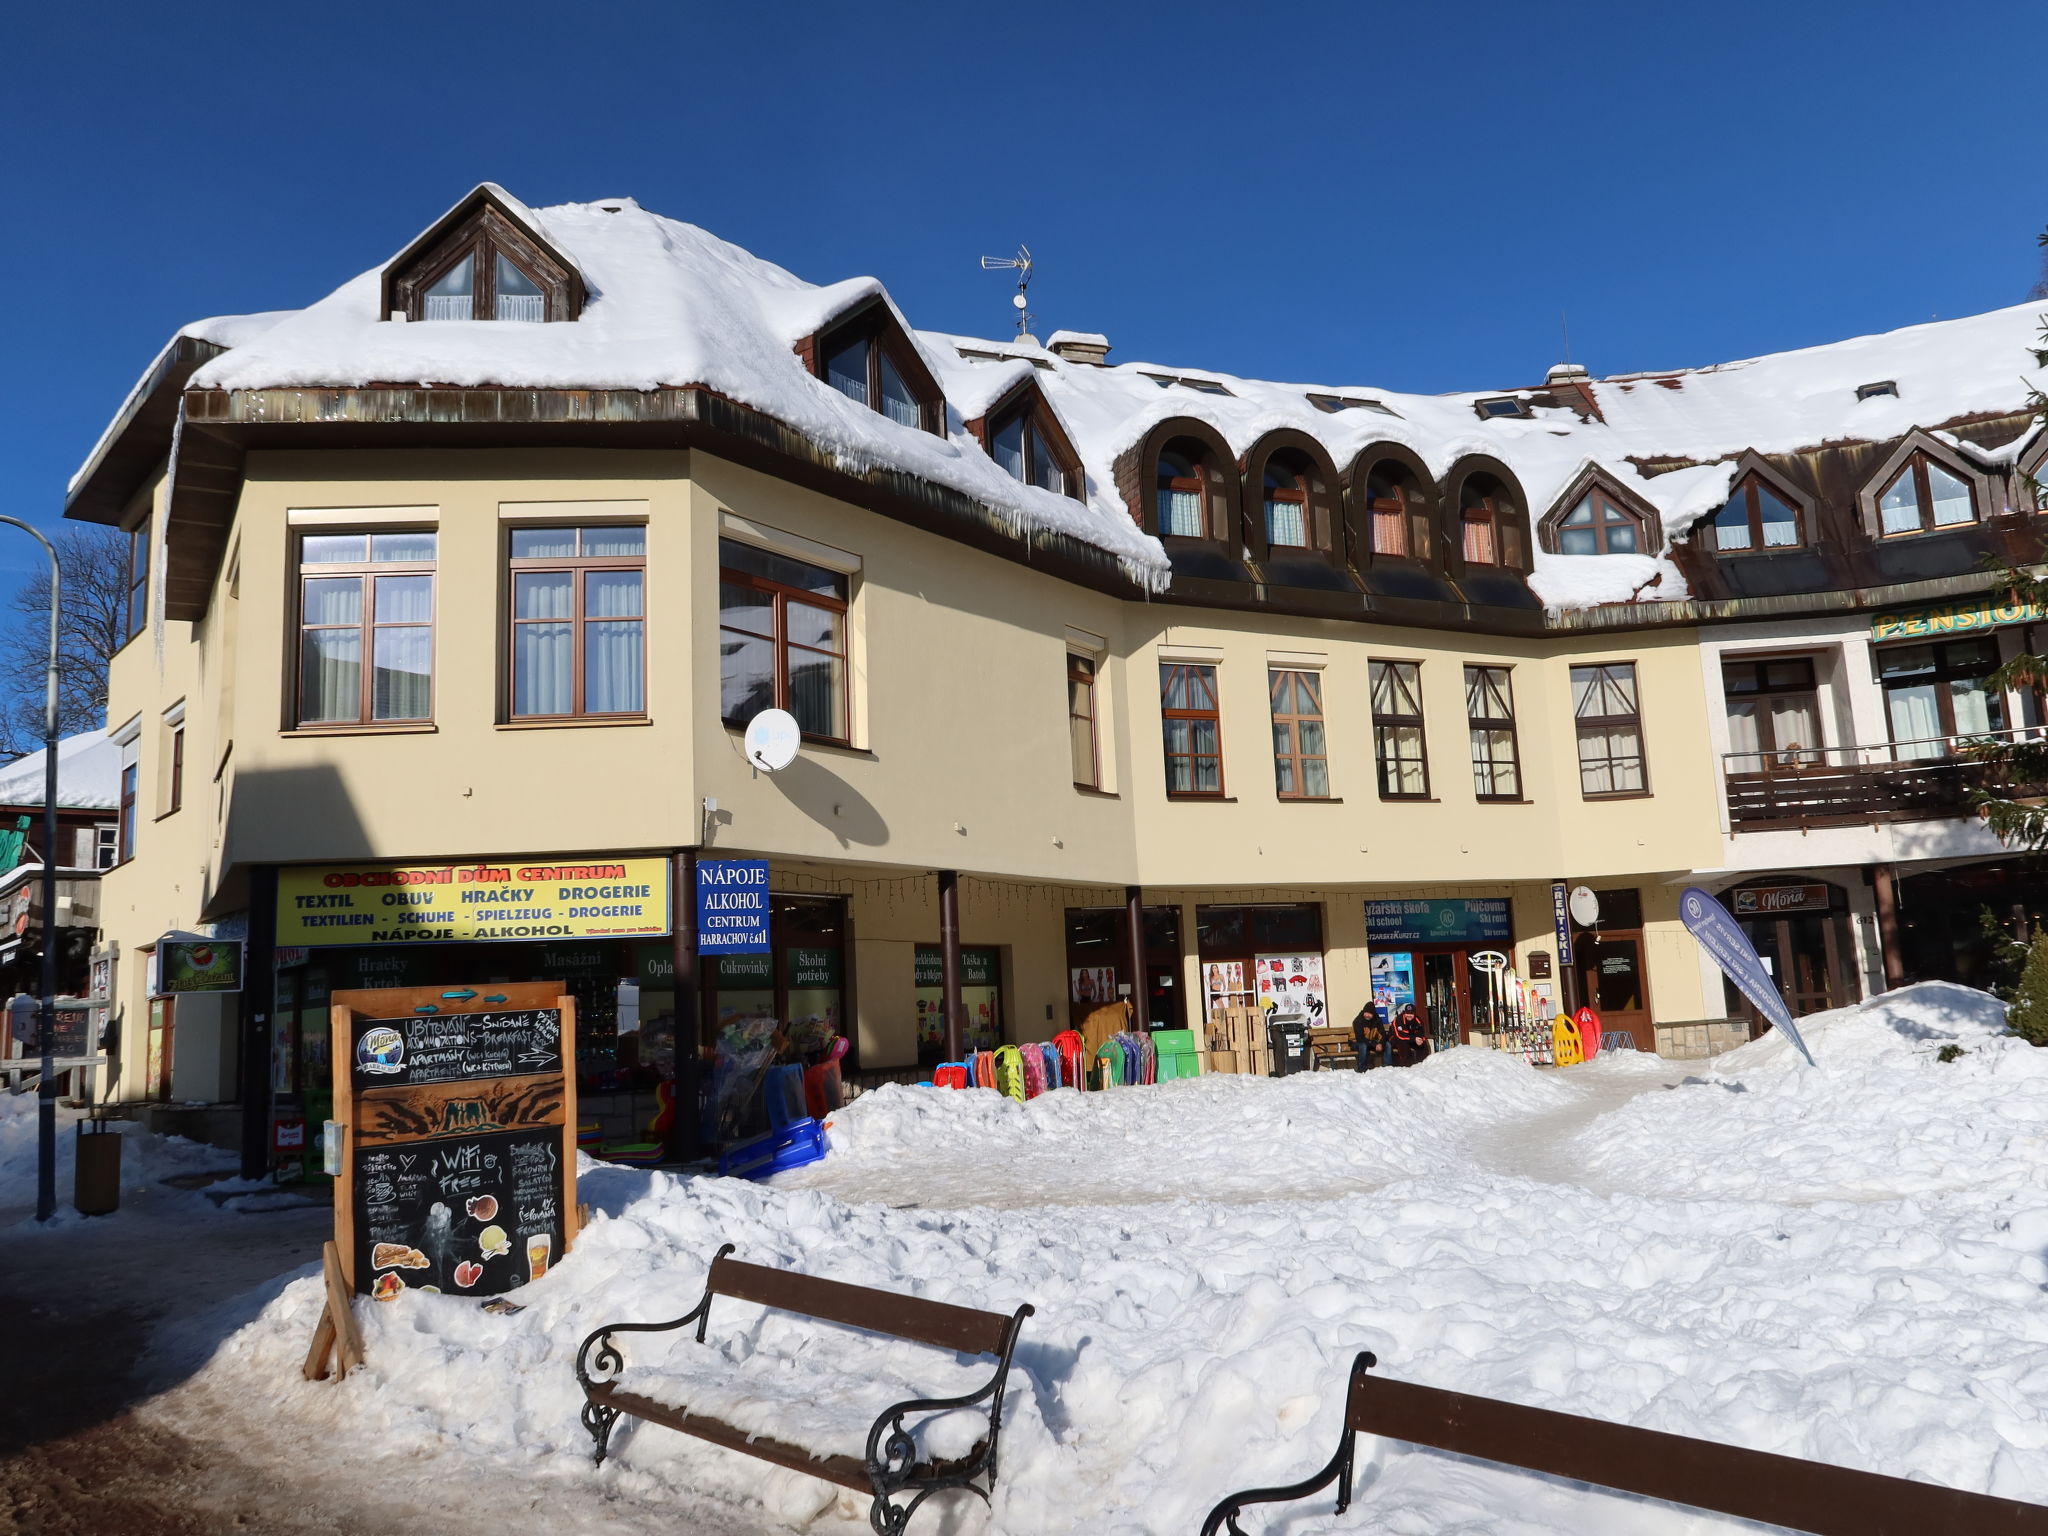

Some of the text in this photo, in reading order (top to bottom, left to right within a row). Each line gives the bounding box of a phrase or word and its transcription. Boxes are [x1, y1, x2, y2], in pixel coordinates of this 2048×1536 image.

[323, 864, 627, 888] OBCHODNÍ DŮM CENTRUM
[700, 865, 766, 885] NÁPOJE
[295, 884, 651, 909] TEXTIL OBUV HRAČKY DROGERIE
[704, 892, 763, 910] ALKOHOL
[302, 914, 375, 927] TEXTILIEN
[398, 911, 455, 924] SCHUHE
[476, 908, 552, 922] SPIELZEUG
[568, 905, 643, 918] DROGERIE
[1404, 901, 1430, 914] škola
[1554, 891, 1566, 925] RENT
[707, 915, 760, 928] CENTRUM
[1377, 916, 1402, 926] school
[1480, 914, 1507, 923] Ski rent
[1856, 916, 1874, 925] 612
[371, 927, 454, 942] NÁPOJE
[474, 925, 574, 938] ALKOHOL
[700, 932, 749, 945] HARRACHOV
[1559, 932, 1568, 958] SKI
[358, 956, 409, 974] Hračky
[543, 951, 601, 967] Masážní
[799, 951, 827, 966] Školní
[962, 954, 981, 966] Taška
[648, 959, 674, 977] Opla
[720, 959, 769, 976] Cukrovinky
[797, 969, 830, 984] potřeby
[483, 1029, 532, 1047] BREAKFAST
[409, 1049, 465, 1066] APARTMÁNY
